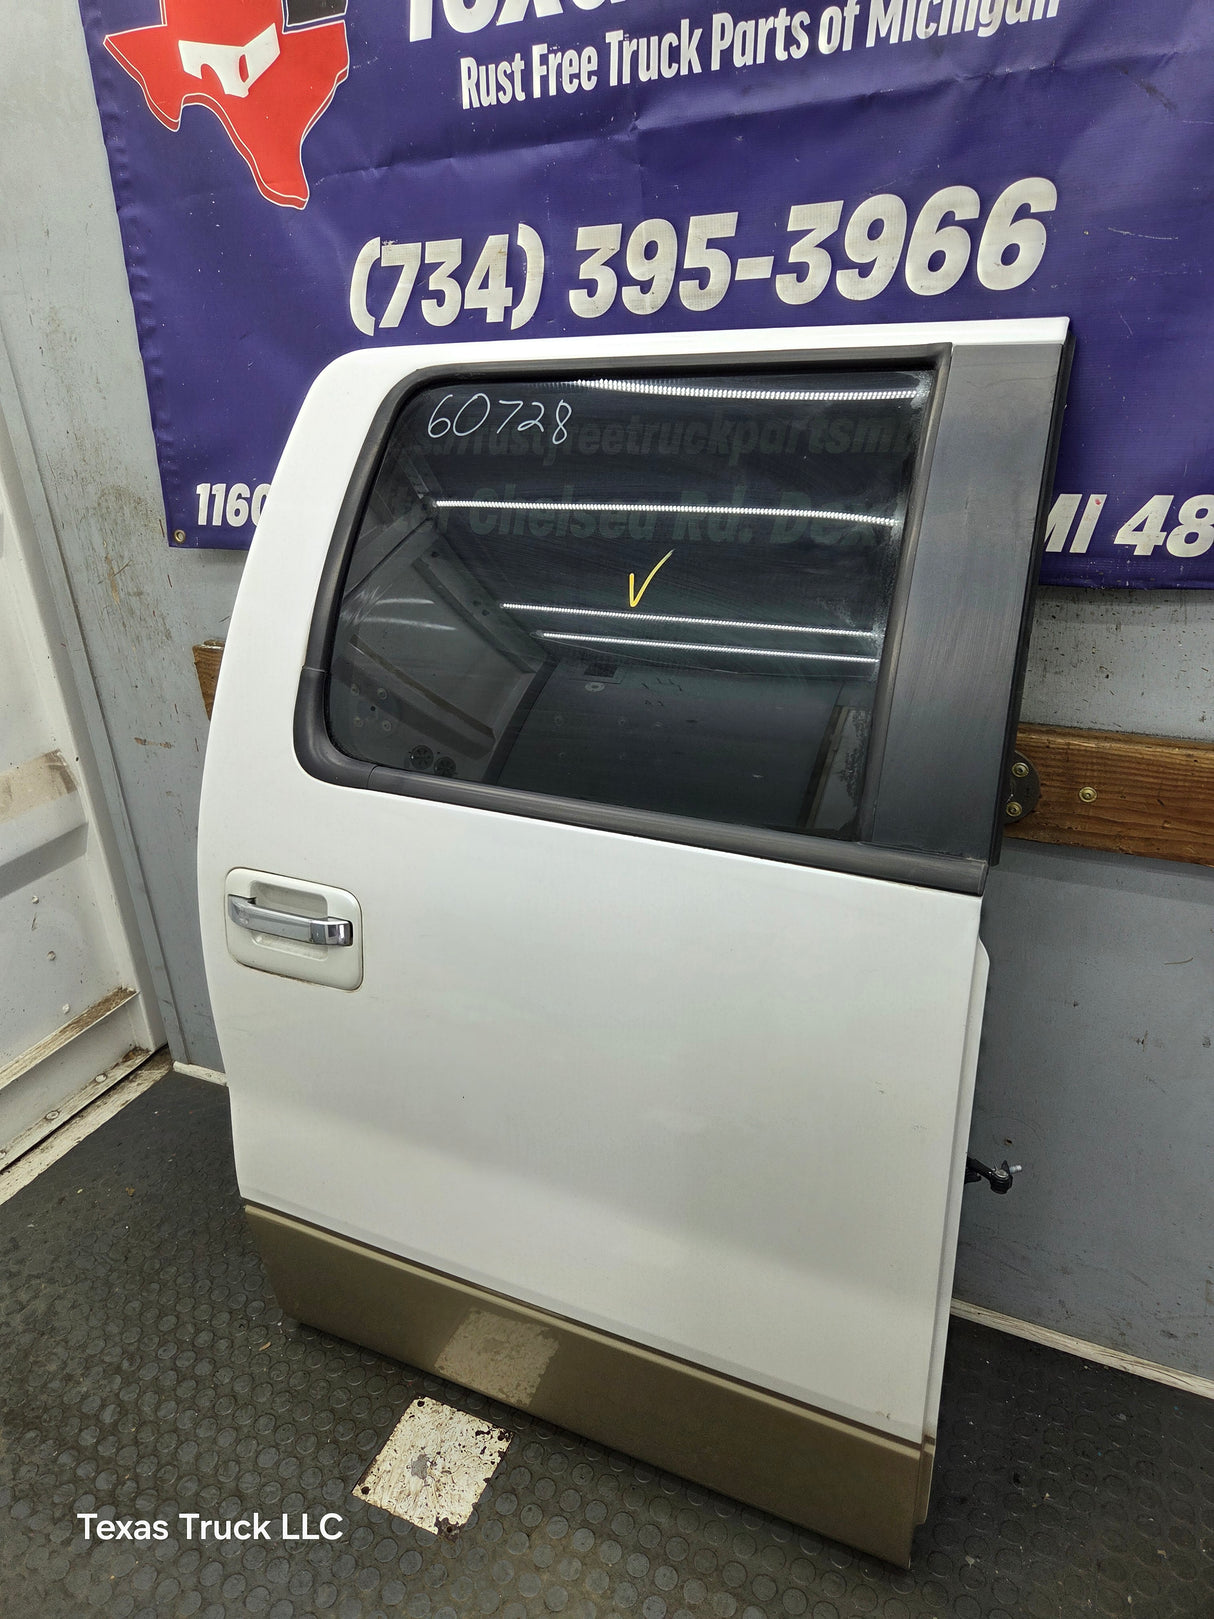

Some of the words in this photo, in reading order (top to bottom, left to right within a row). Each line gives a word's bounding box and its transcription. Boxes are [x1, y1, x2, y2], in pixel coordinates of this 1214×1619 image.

[460, 56, 526, 110] Rust
[532, 43, 598, 99] Free
[605, 18, 703, 87] Truck
[711, 8, 811, 71] Parts
[817, 0, 860, 54] of
[350, 223, 546, 336] (734)
[568, 176, 1058, 318] 395-3966
[427, 393, 573, 445] 60728
[1113, 494, 1214, 557] 48
